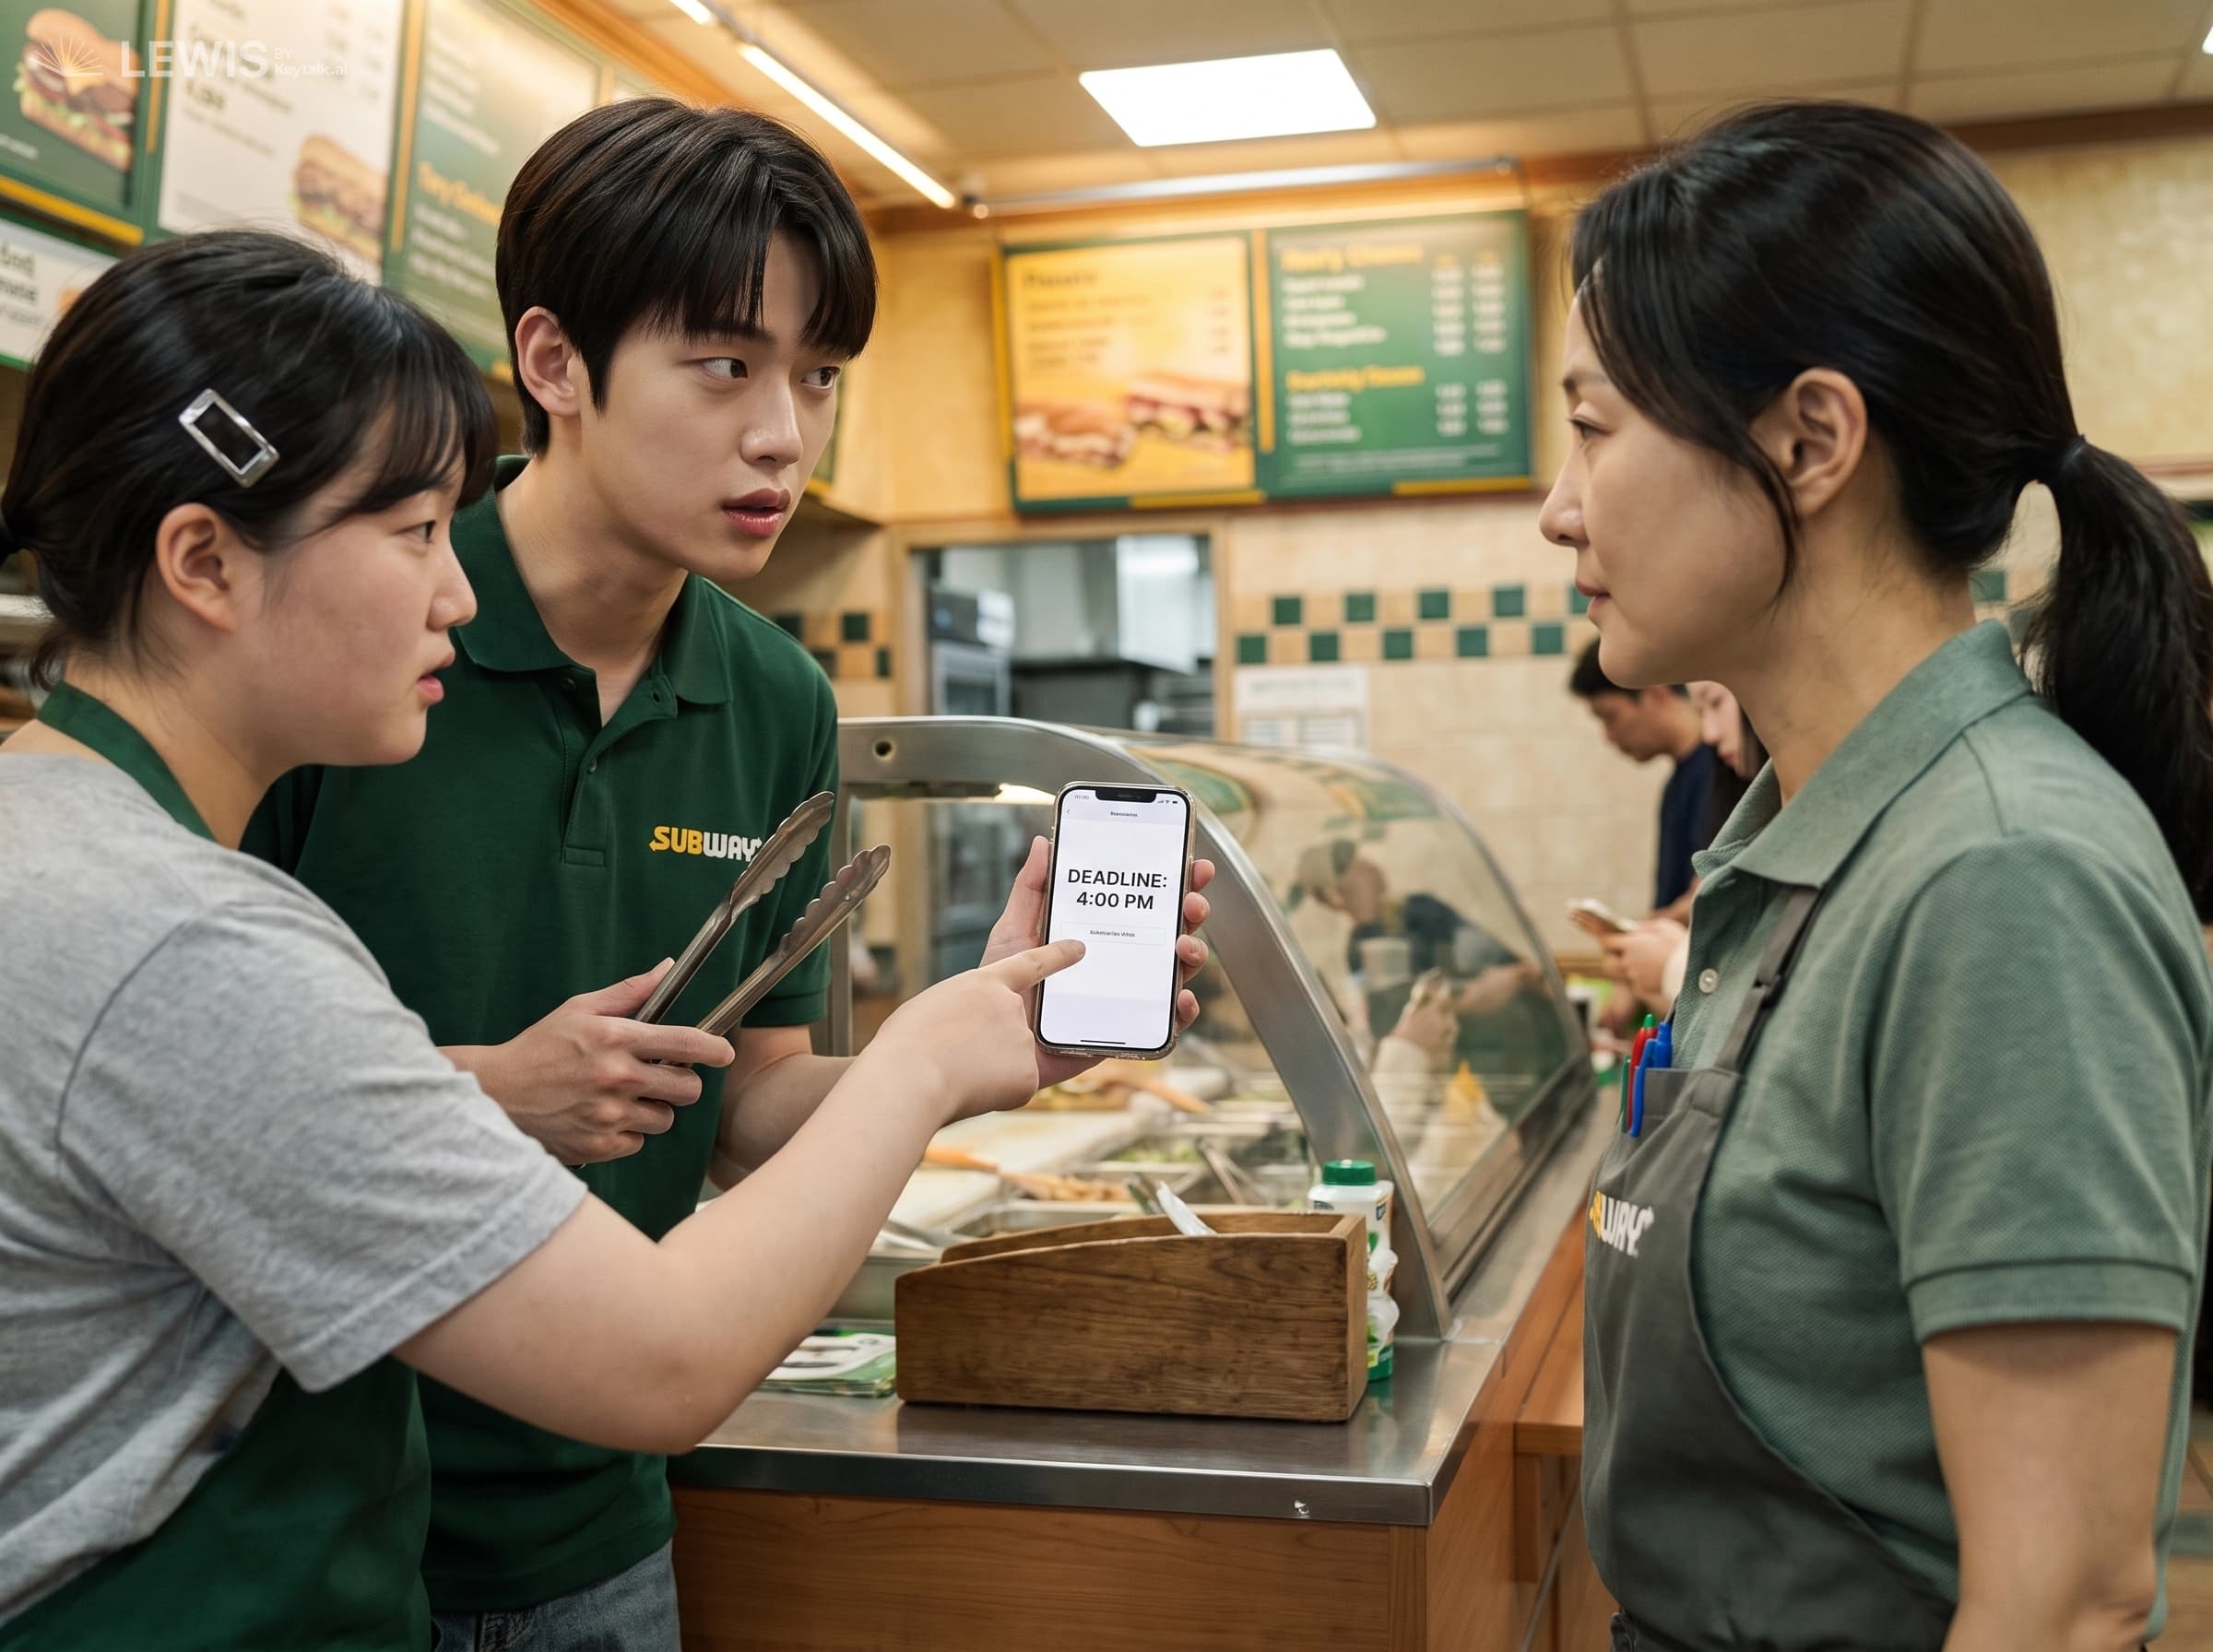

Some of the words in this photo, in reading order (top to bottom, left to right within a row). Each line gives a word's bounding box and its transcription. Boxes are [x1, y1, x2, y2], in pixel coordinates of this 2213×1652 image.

[649, 826, 763, 862] SUBWAY
[1068, 868, 1167, 888] DEADLINE:
[1076, 891, 1119, 907] 4:00
[1125, 894, 1154, 909] PM
